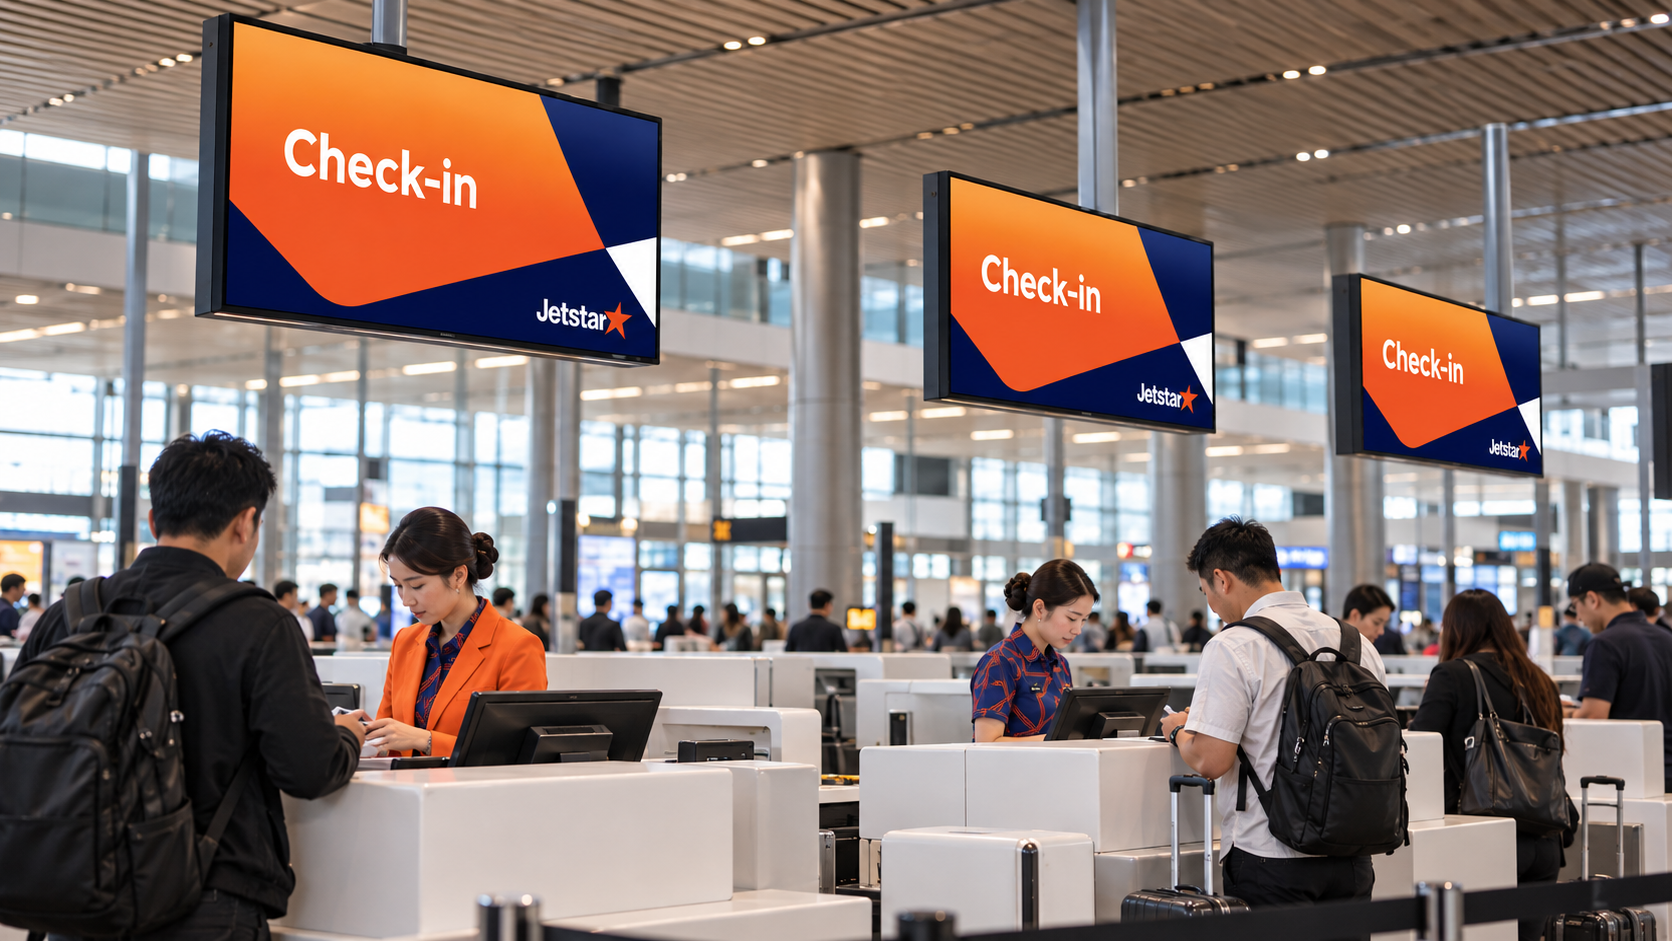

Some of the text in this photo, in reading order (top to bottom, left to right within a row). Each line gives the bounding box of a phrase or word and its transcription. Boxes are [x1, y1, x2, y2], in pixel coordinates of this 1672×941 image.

[284, 128, 477, 210] Check-in
[981, 254, 1101, 314] Check-in
[536, 298, 608, 331] Jetstar
[1382, 338, 1464, 385] Check-in
[1137, 382, 1182, 408] Jetstar
[1489, 438, 1520, 459] Jetstar
